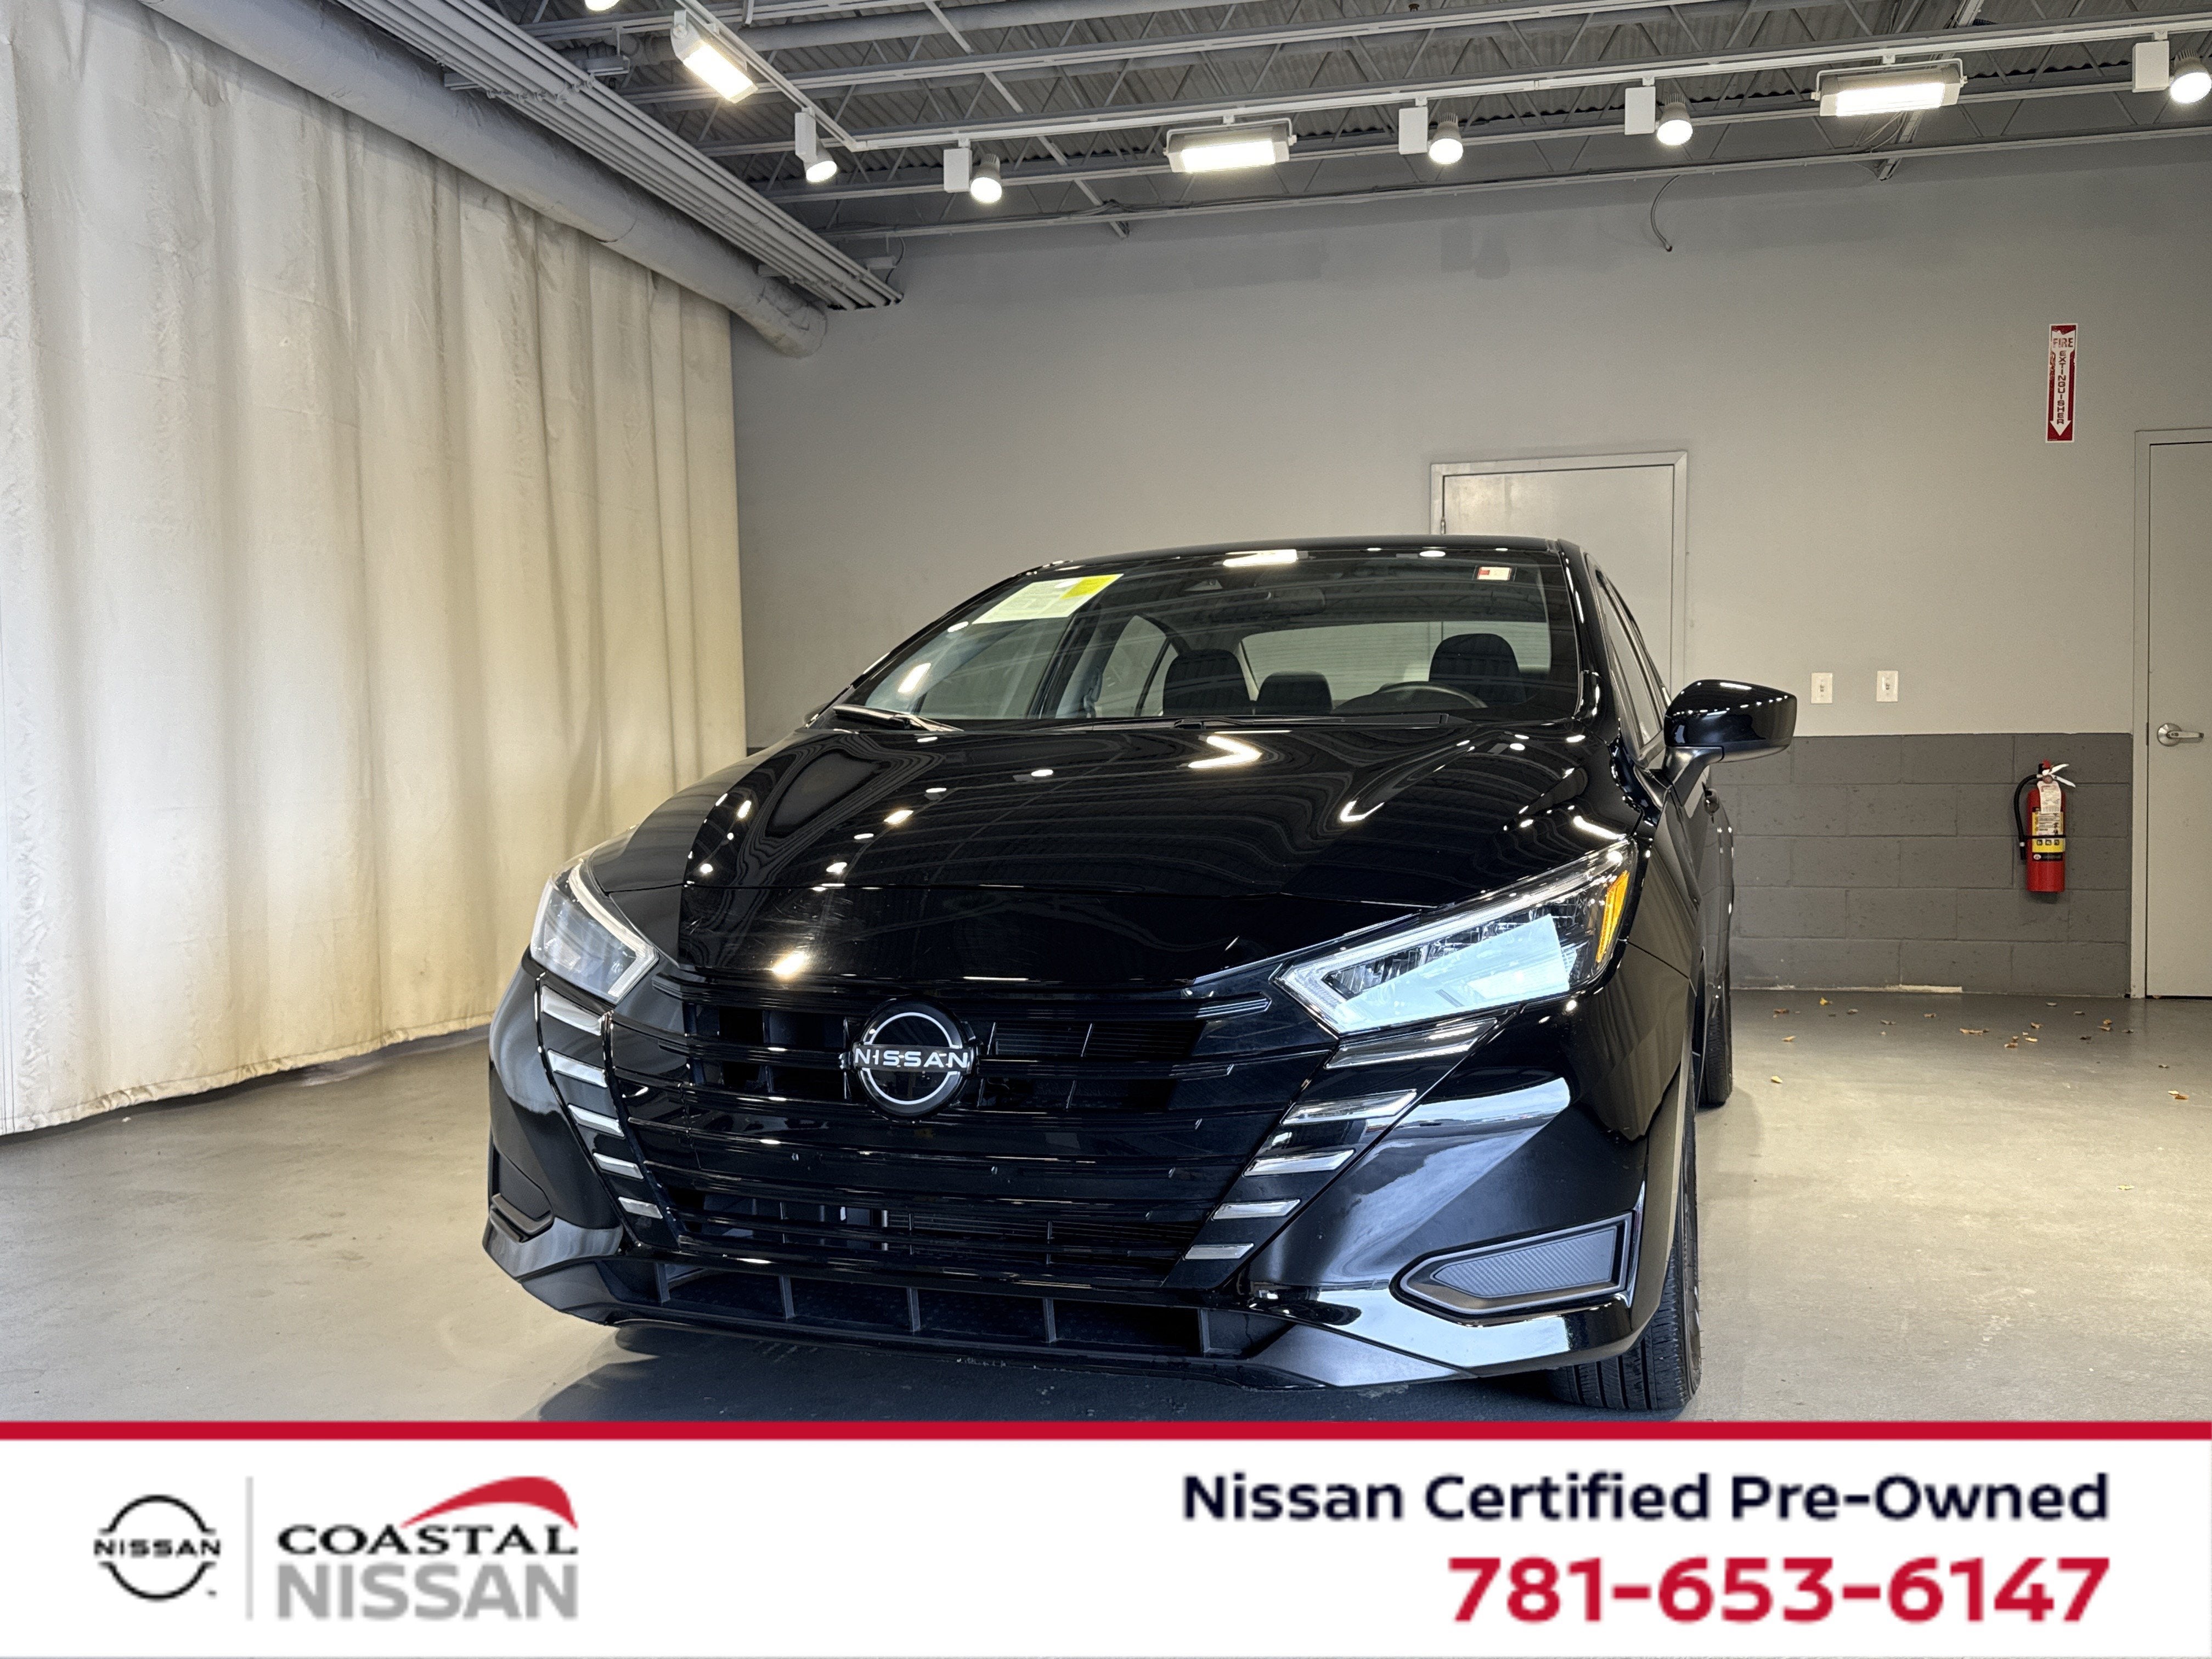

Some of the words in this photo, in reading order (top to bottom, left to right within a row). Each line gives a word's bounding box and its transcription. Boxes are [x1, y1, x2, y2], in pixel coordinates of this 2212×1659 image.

[2052, 337, 2074, 348] FIRE
[2056, 349, 2067, 425] EXTINGUISHER
[854, 1048, 969, 1068] NISSAN
